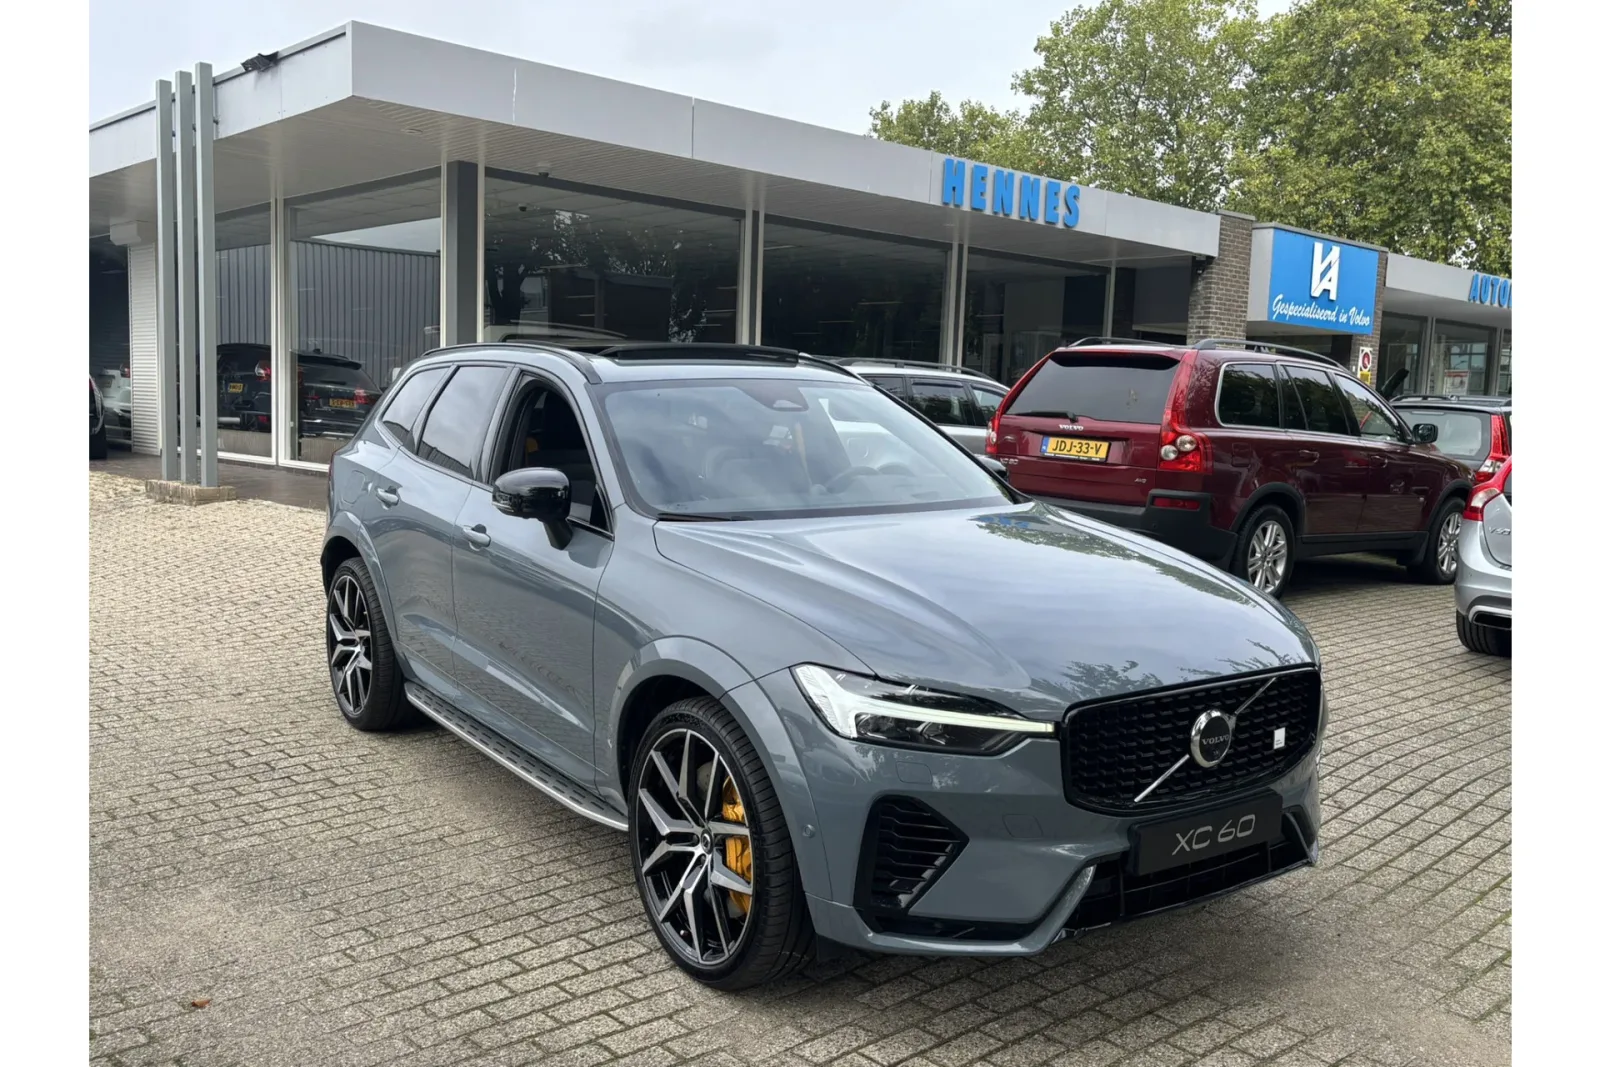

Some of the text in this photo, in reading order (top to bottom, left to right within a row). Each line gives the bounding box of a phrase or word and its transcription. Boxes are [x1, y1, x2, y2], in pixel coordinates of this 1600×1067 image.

[943, 158, 1080, 228] HENNES
[1272, 294, 1371, 326] Gespecialiseerd in Volvo
[1052, 440, 1102, 455] JDJ-33-V
[1202, 734, 1230, 745] VOLVO
[1172, 814, 1256, 856] XC 60
